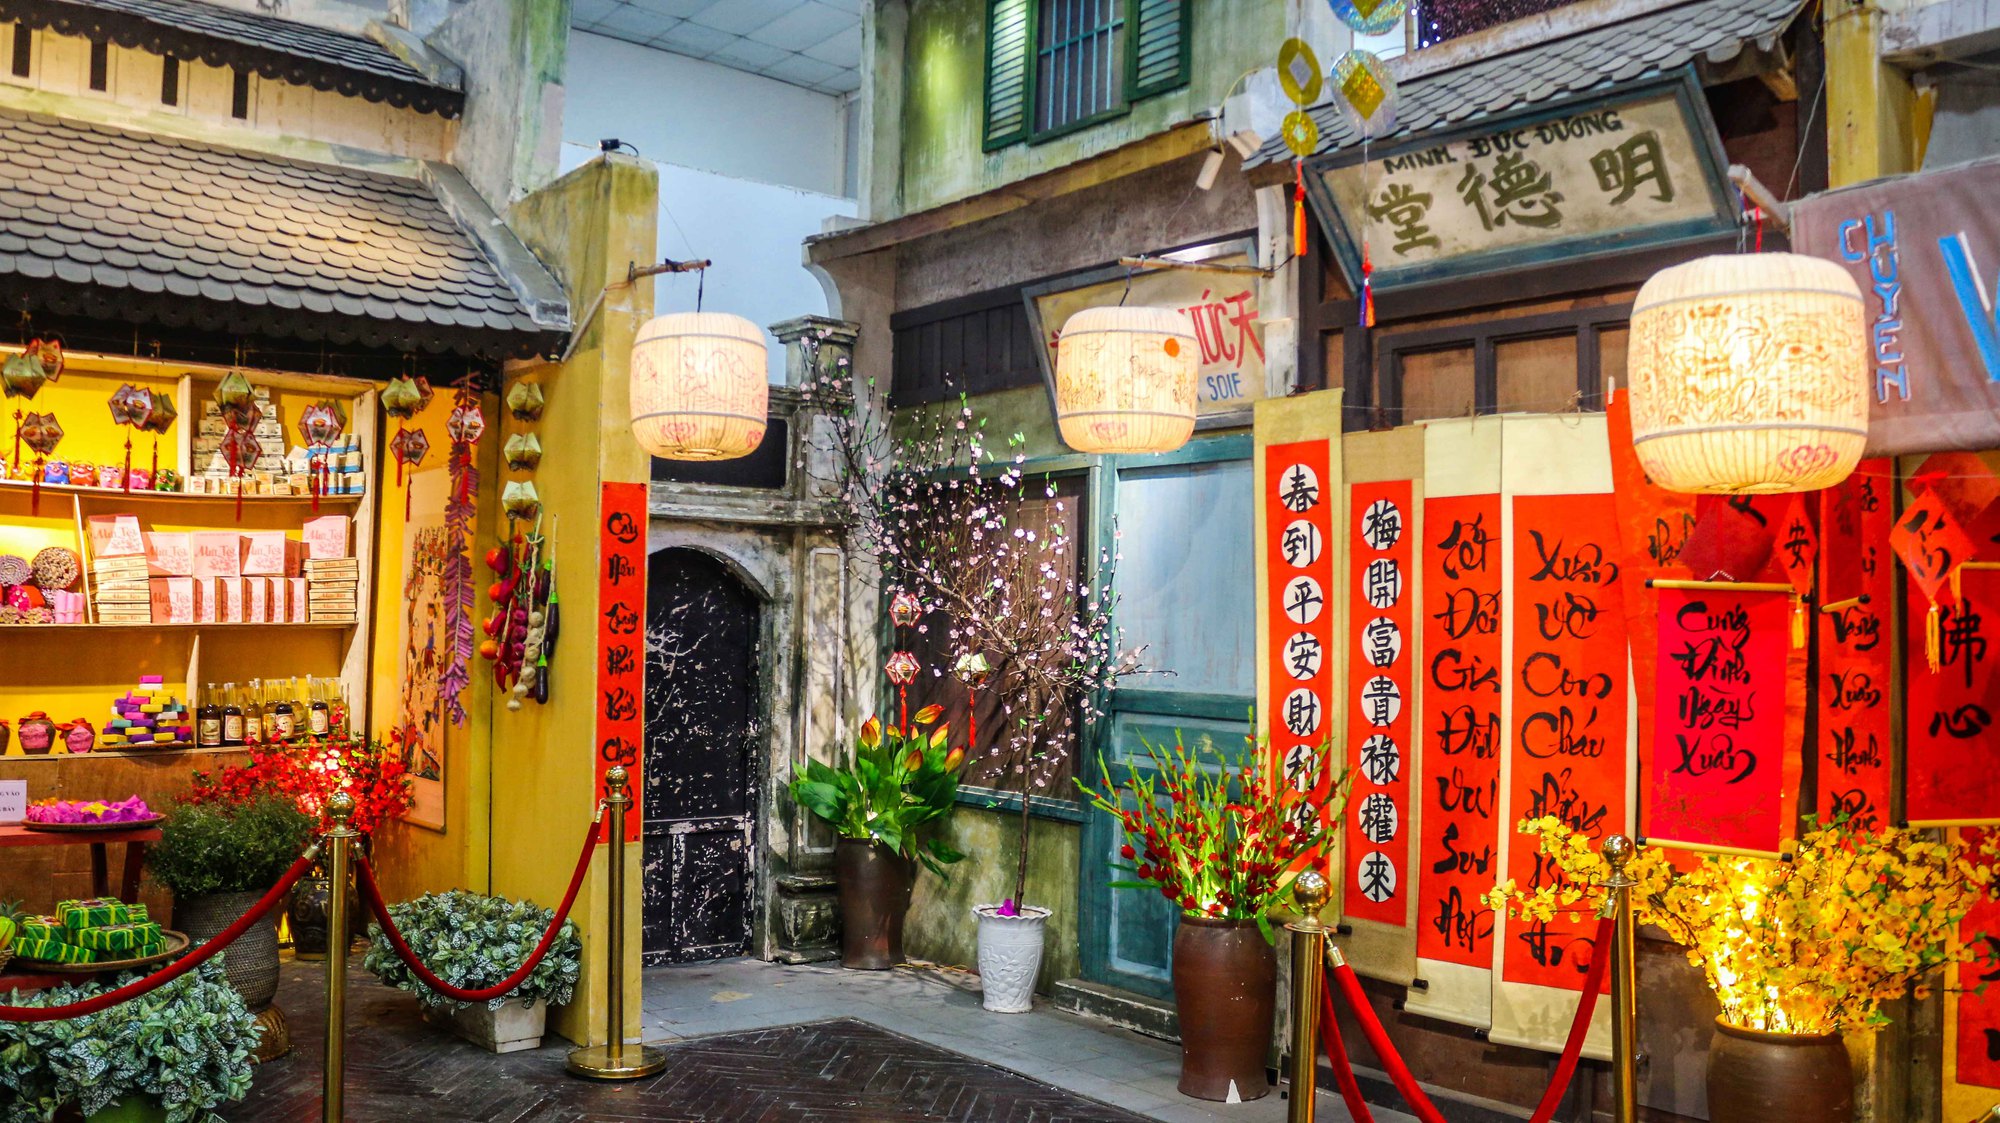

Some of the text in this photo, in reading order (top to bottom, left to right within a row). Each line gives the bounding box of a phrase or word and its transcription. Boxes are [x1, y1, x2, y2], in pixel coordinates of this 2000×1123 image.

[1207, 372, 1245, 402] SOIE
[1281, 463, 1323, 838] 春到平安財利
